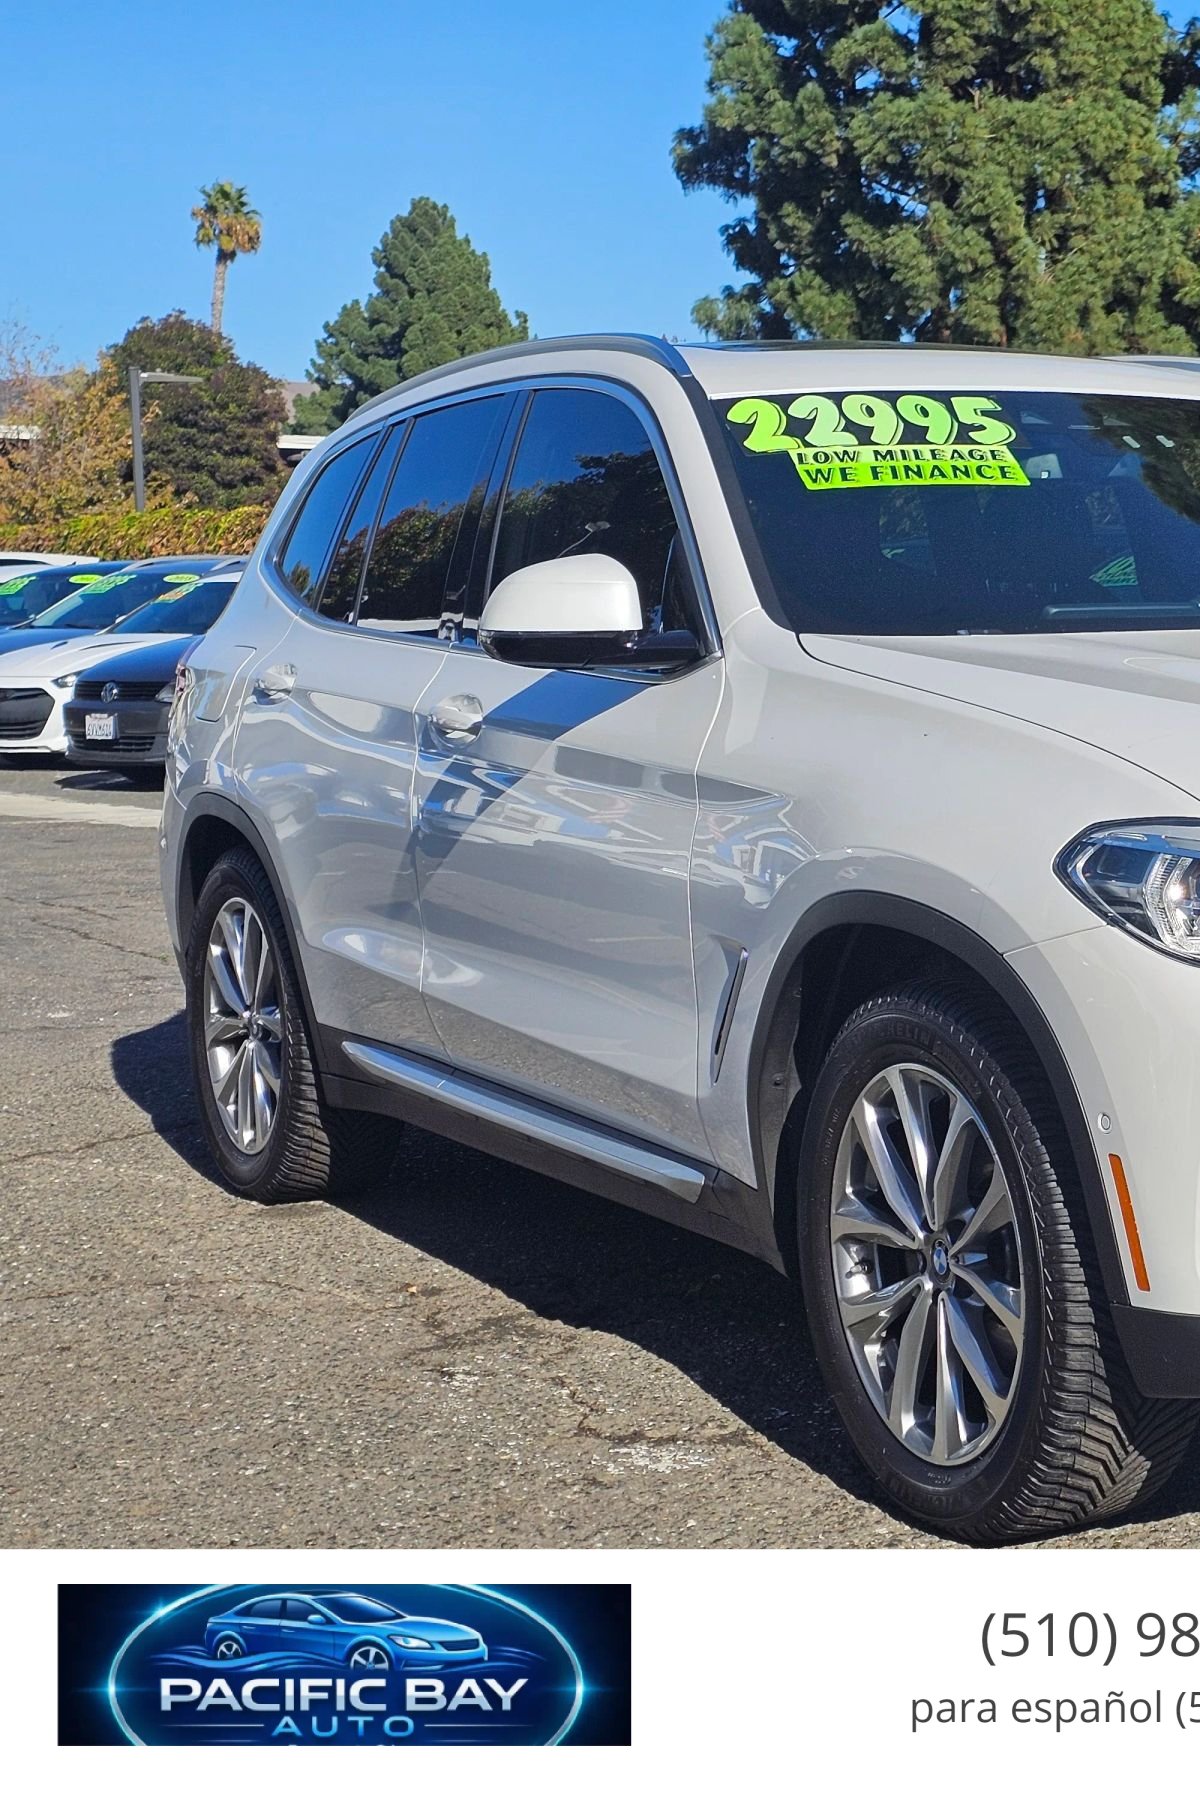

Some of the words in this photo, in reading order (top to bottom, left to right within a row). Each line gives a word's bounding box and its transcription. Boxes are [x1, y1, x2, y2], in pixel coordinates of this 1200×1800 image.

[727, 394, 1017, 453] 22995
[797, 449, 861, 465] LOW
[874, 447, 1010, 463] MILEAGE
[804, 467, 859, 484] WE
[871, 465, 1021, 482] FINANCE
